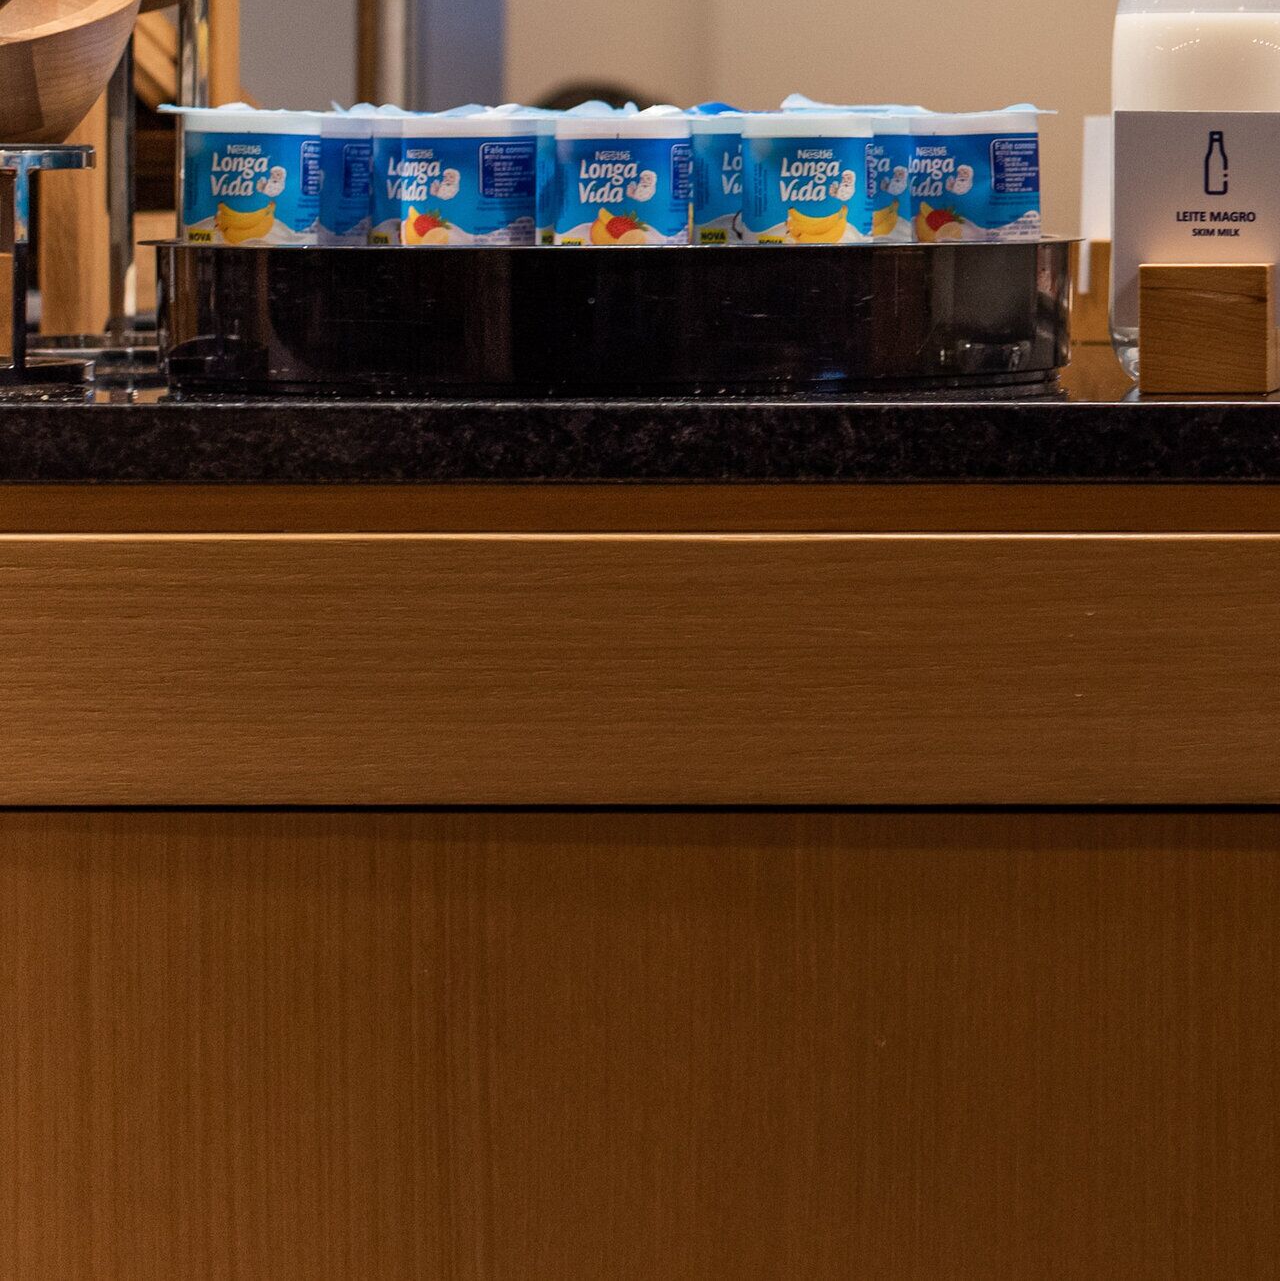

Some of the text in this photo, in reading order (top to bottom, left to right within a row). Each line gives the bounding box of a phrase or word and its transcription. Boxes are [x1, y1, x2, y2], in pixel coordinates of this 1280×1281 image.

[227, 144, 262, 155] Nestlé
[797, 149, 833, 159] Nestlé
[595, 150, 631, 161] Nestlé
[211, 152, 269, 179] Longa
[780, 158, 840, 184] Longa
[579, 159, 638, 185] Longa
[210, 173, 255, 197] Vida
[779, 179, 827, 202] Vida
[578, 180, 624, 204] Vida
[1176, 211, 1256, 222] LEITE MAGRO
[188, 232, 211, 242] NOVA
[701, 231, 726, 241] NOVA
[1191, 228, 1240, 237] SKIM MILK
